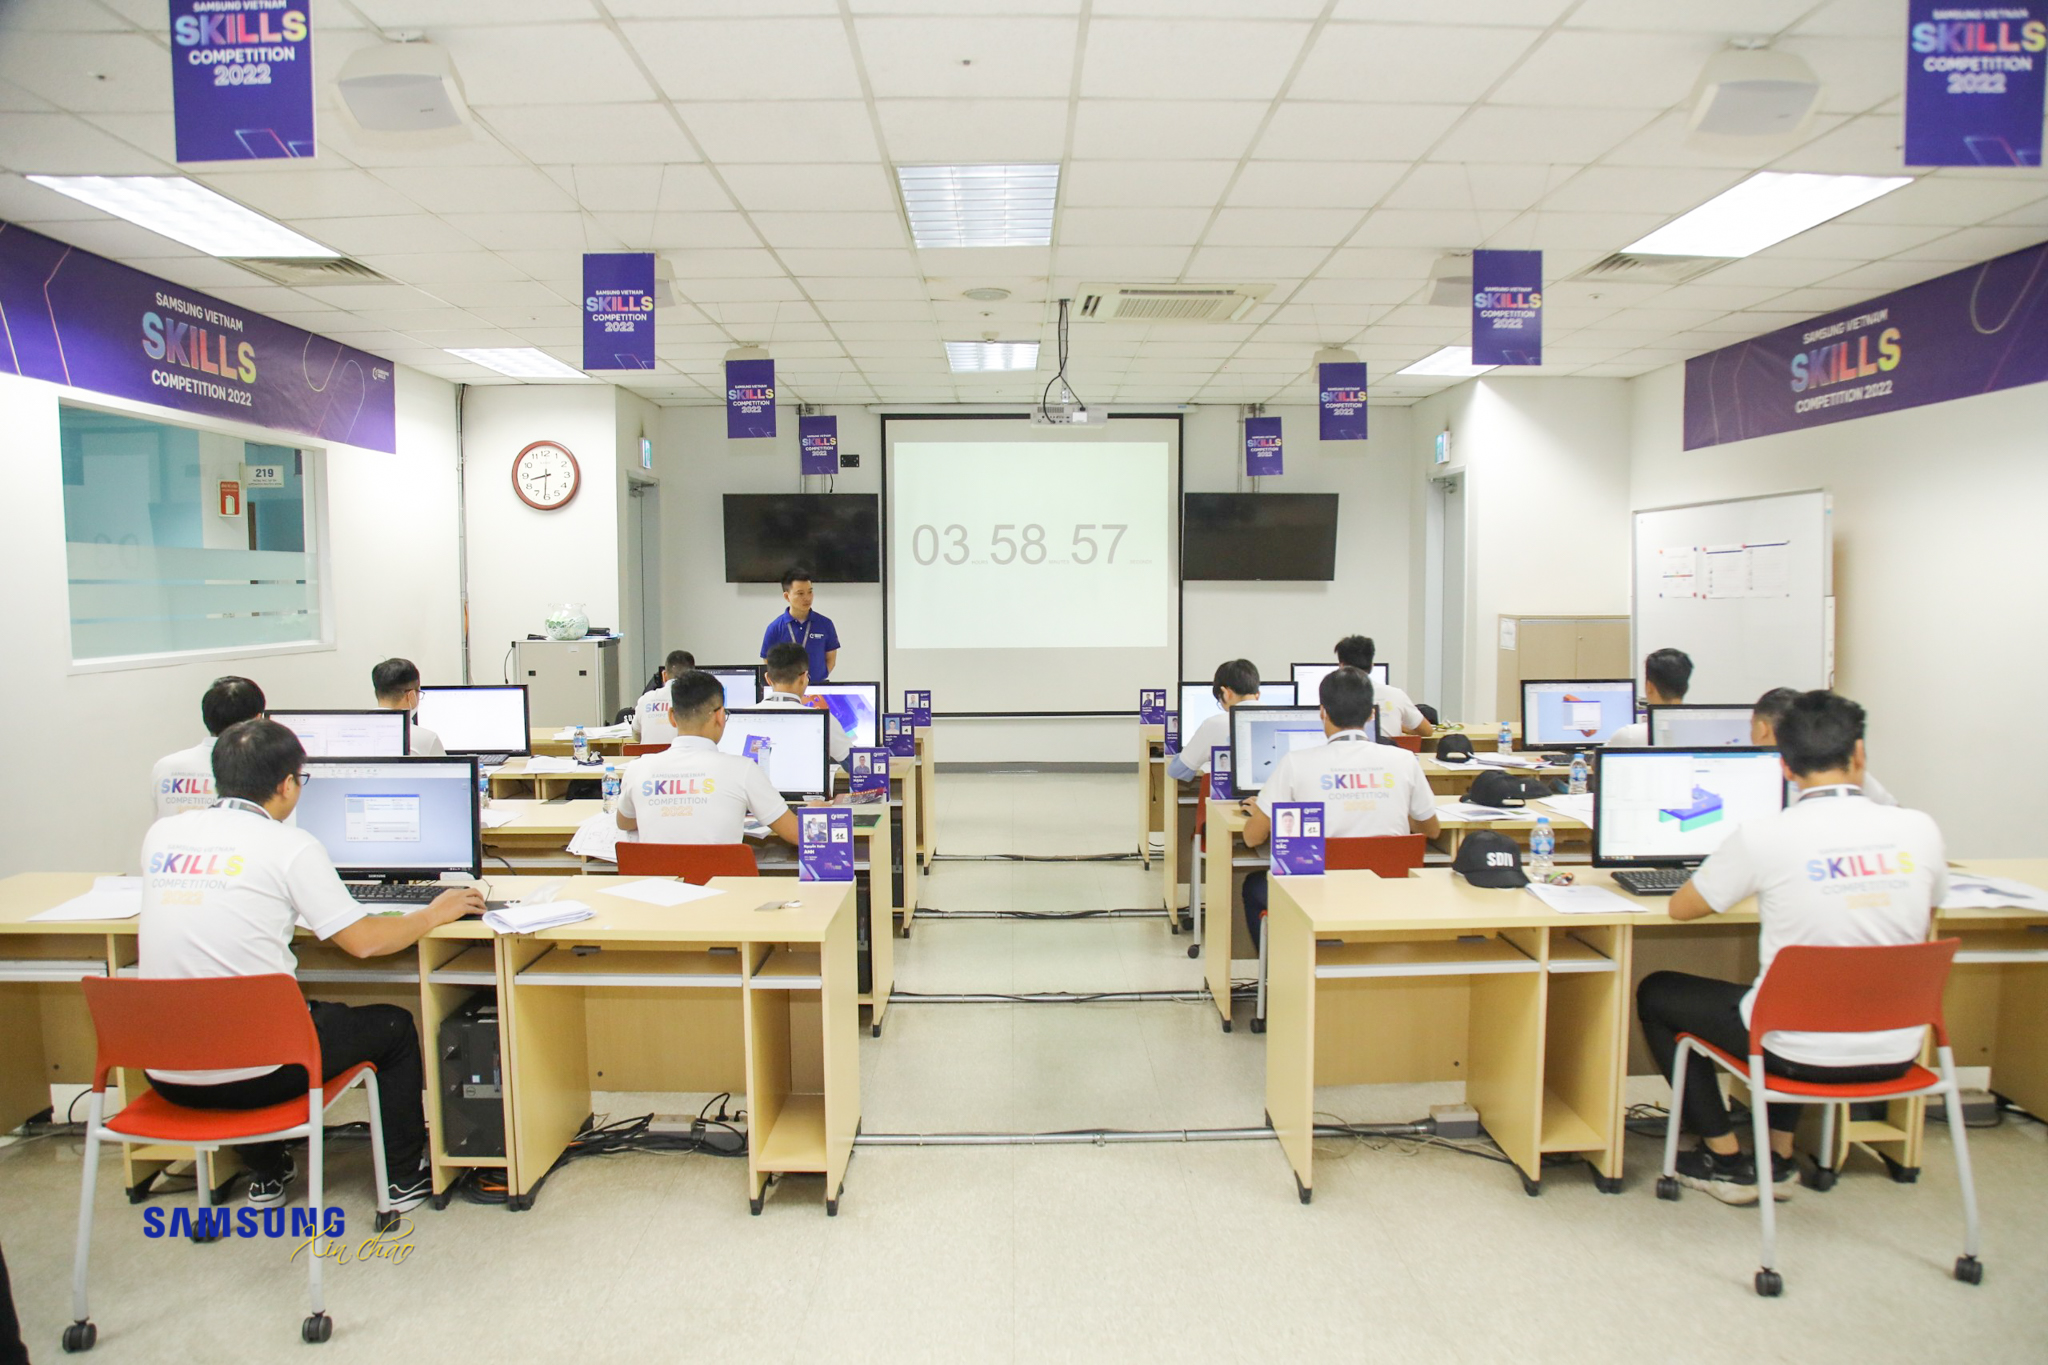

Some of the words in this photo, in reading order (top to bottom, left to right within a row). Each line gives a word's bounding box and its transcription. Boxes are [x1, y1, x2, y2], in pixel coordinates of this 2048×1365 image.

[175, 10, 308, 46] SKILLS
[1911, 21, 2047, 53] SKILLS
[188, 46, 296, 65] COMPETITION
[1923, 55, 2033, 72] COMPETITION
[213, 63, 272, 86] 2022
[586, 295, 654, 312] SKILLS
[1474, 292, 1542, 309] SKILLS
[155, 292, 204, 319] SAMSUNG
[204, 308, 244, 333] VIETNAM
[592, 313, 647, 321] COMPETITION
[1480, 310, 1536, 318] COMPETITION
[604, 321, 635, 332] 2022
[142, 311, 257, 384] SKILLS
[1790, 327, 1902, 393] SKILLS
[151, 369, 227, 401] COMPETITION
[227, 388, 252, 407] 2022
[728, 388, 774, 400] SKILLS
[1321, 391, 1368, 402] SKILLS
[1794, 387, 1864, 413] COMPETITION
[1863, 380, 1894, 400] 2022
[802, 437, 837, 446] SKILLS
[1247, 438, 1282, 447] SKILLS
[255, 468, 274, 478] 219
[522, 472, 529, 480] 9
[553, 489, 560, 497] 5
[912, 524, 970, 566] 03
[990, 523, 1047, 566] 58
[1071, 524, 1128, 565] 57
[160, 778, 214, 795] SKILL
[641, 778, 715, 797] SKILLS
[1320, 772, 1395, 791] SKILLS
[648, 796, 708, 807] COMPETITION
[1328, 791, 1390, 800] COMPETITION
[149, 852, 245, 877] SKILLS
[1805, 851, 1916, 882] SKILLS
[151, 878, 227, 889] COMPETITION
